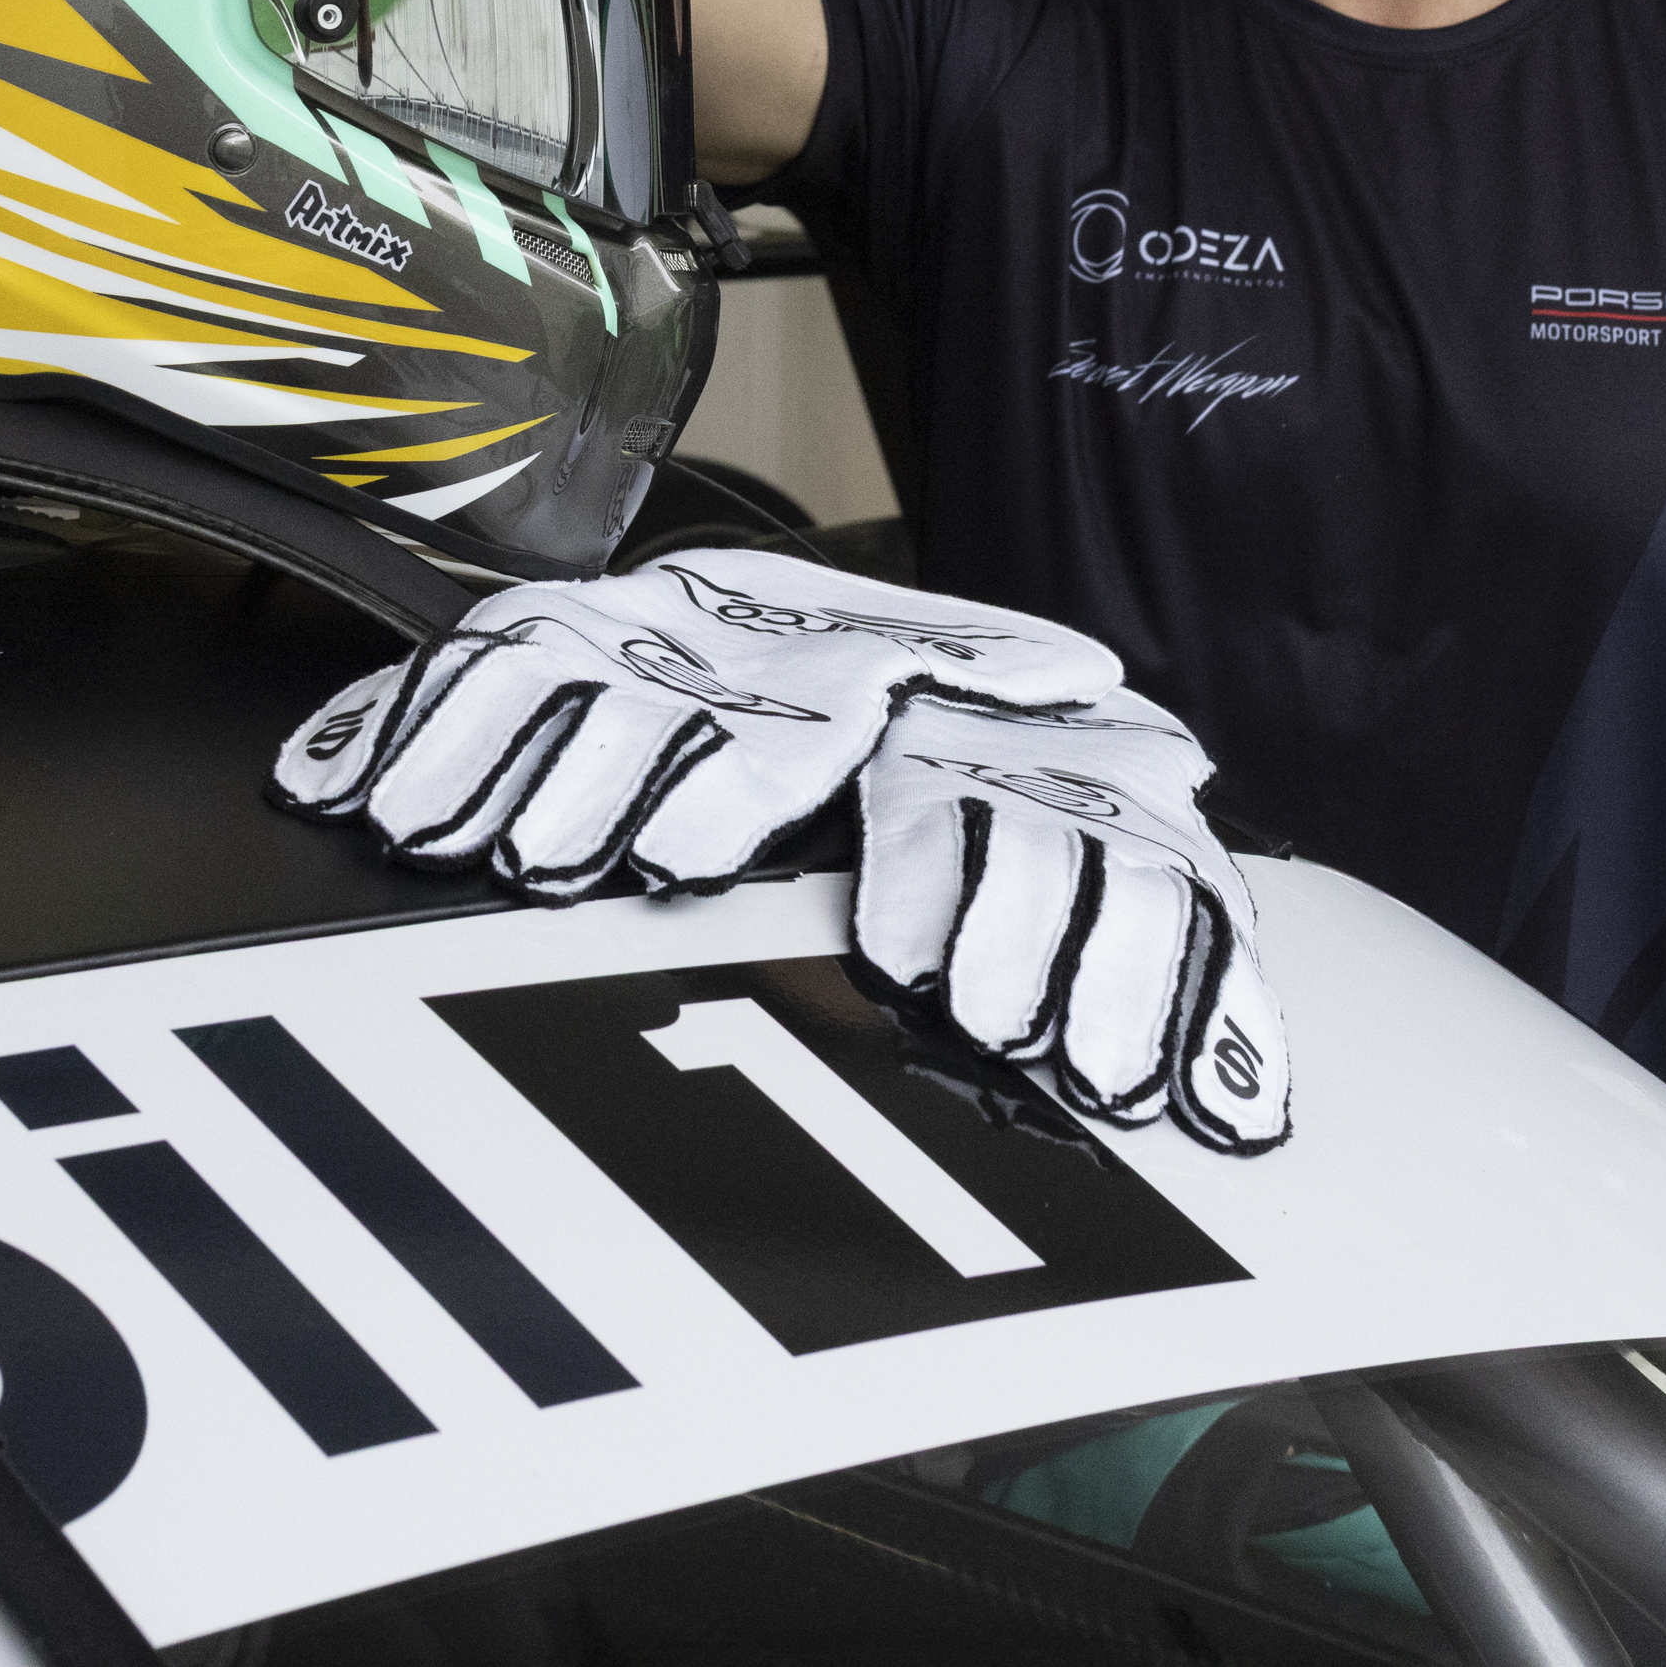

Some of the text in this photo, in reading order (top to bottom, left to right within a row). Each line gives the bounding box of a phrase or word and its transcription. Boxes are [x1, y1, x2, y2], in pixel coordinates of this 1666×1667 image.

[284, 178, 414, 273] Artmix
[1530, 322, 1662, 347] MOTORSPORT
[639, 996, 1046, 1279] 1
